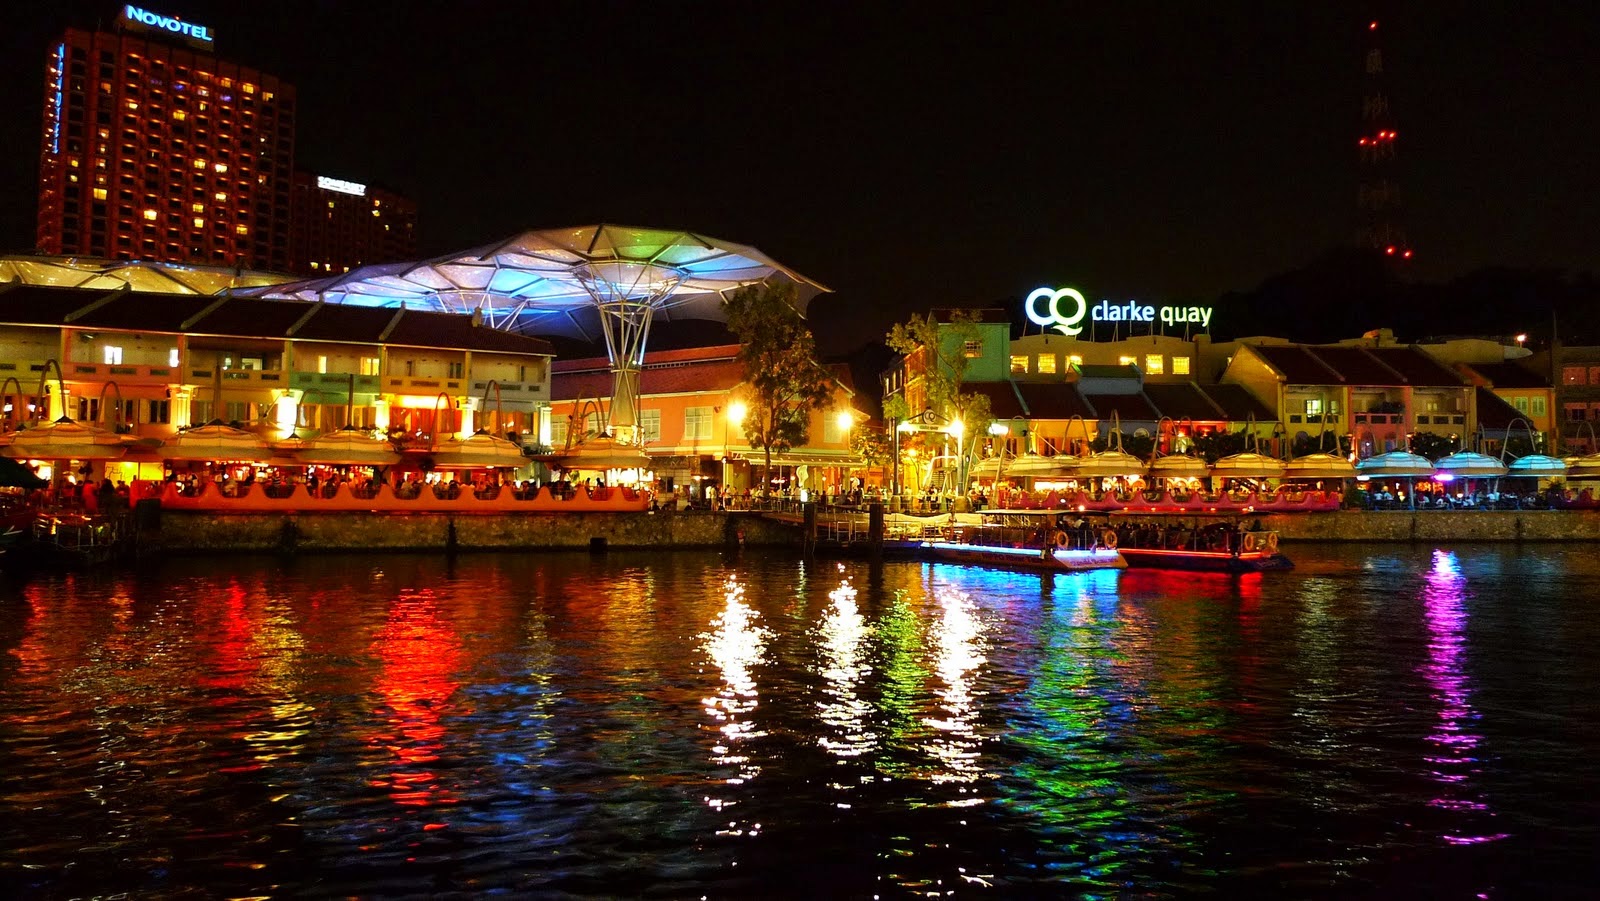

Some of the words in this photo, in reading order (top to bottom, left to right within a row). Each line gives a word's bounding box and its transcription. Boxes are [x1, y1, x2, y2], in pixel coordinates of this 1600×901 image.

[126, 5, 212, 41] NOVOTEL
[1025, 287, 1086, 336] CQ
[1091, 300, 1155, 321] clarke
[1160, 305, 1212, 327] quay
